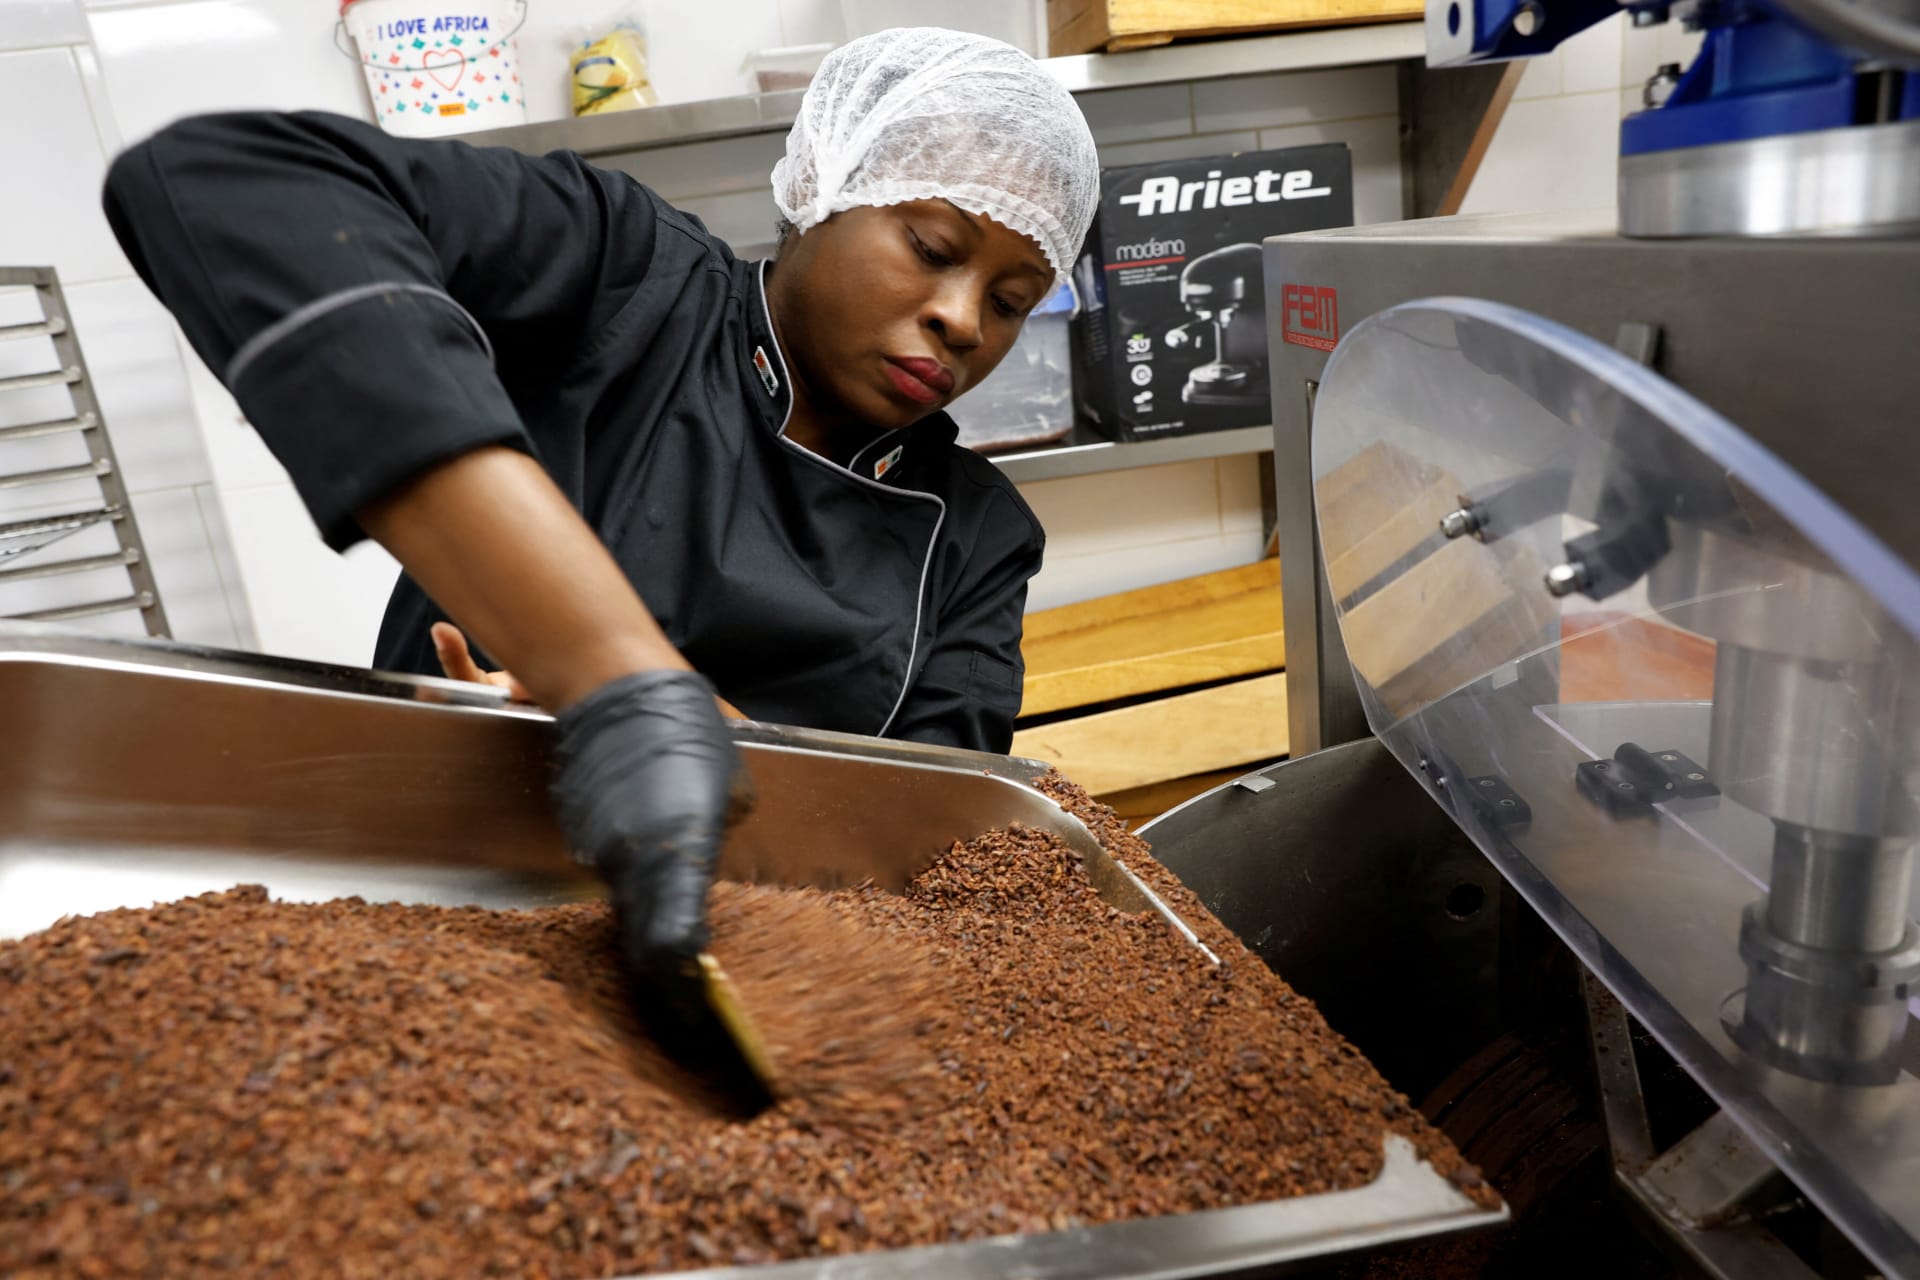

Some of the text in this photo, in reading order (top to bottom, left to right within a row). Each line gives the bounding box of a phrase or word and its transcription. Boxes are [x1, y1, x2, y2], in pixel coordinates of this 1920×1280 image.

[388, 18, 427, 38] LOVE
[433, 16, 489, 32] AFRICA
[1119, 169, 1332, 217] Ariete
[1284, 285, 1337, 336] FBM
